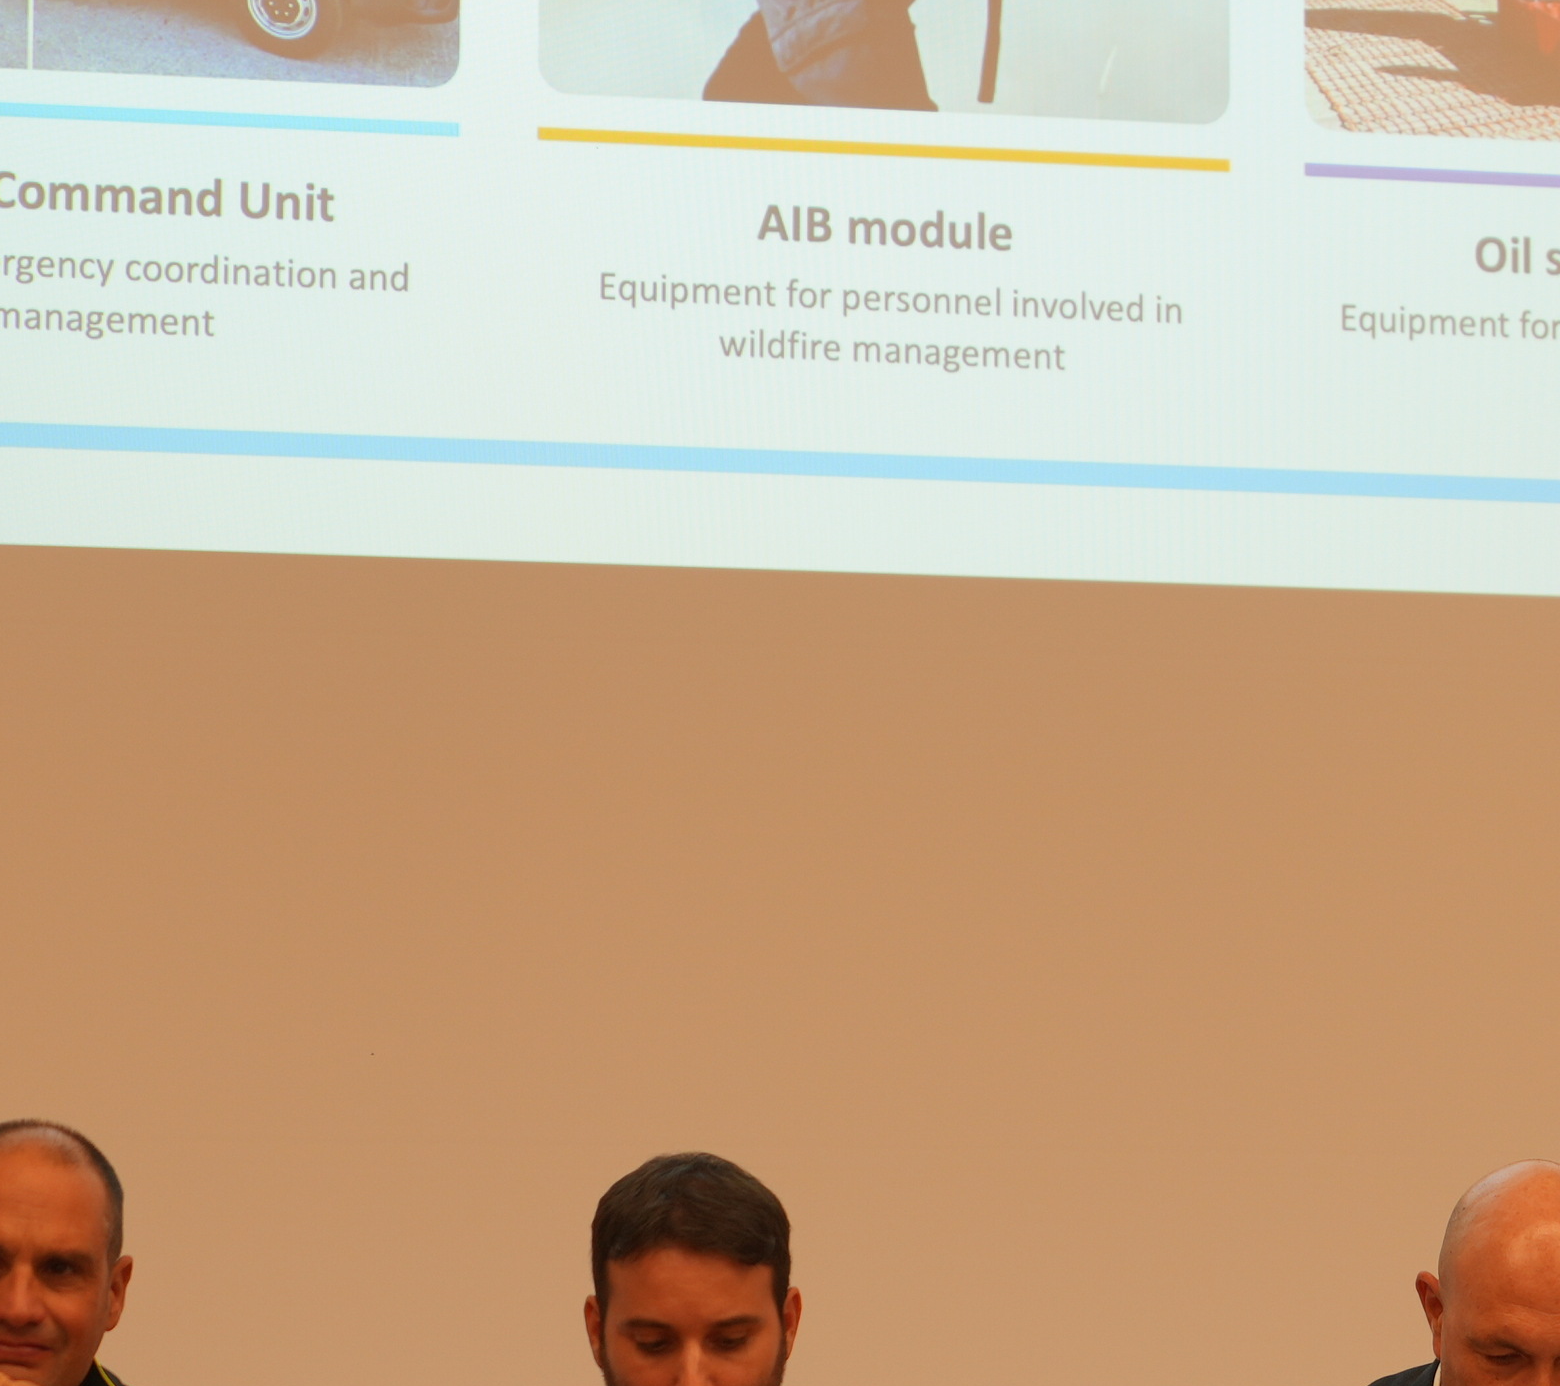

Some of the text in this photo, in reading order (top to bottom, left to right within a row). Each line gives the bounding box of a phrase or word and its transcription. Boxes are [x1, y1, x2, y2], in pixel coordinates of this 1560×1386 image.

[238, 181, 335, 222] Unit
[756, 204, 1014, 252] AIB module
[125, 254, 337, 290] coordination
[348, 262, 410, 293] and
[1474, 236, 1532, 275] Oil
[600, 272, 1184, 325] Equipment for personnel involved in
[1340, 304, 1511, 342] Equipment
[720, 329, 1066, 373] wildfire management
